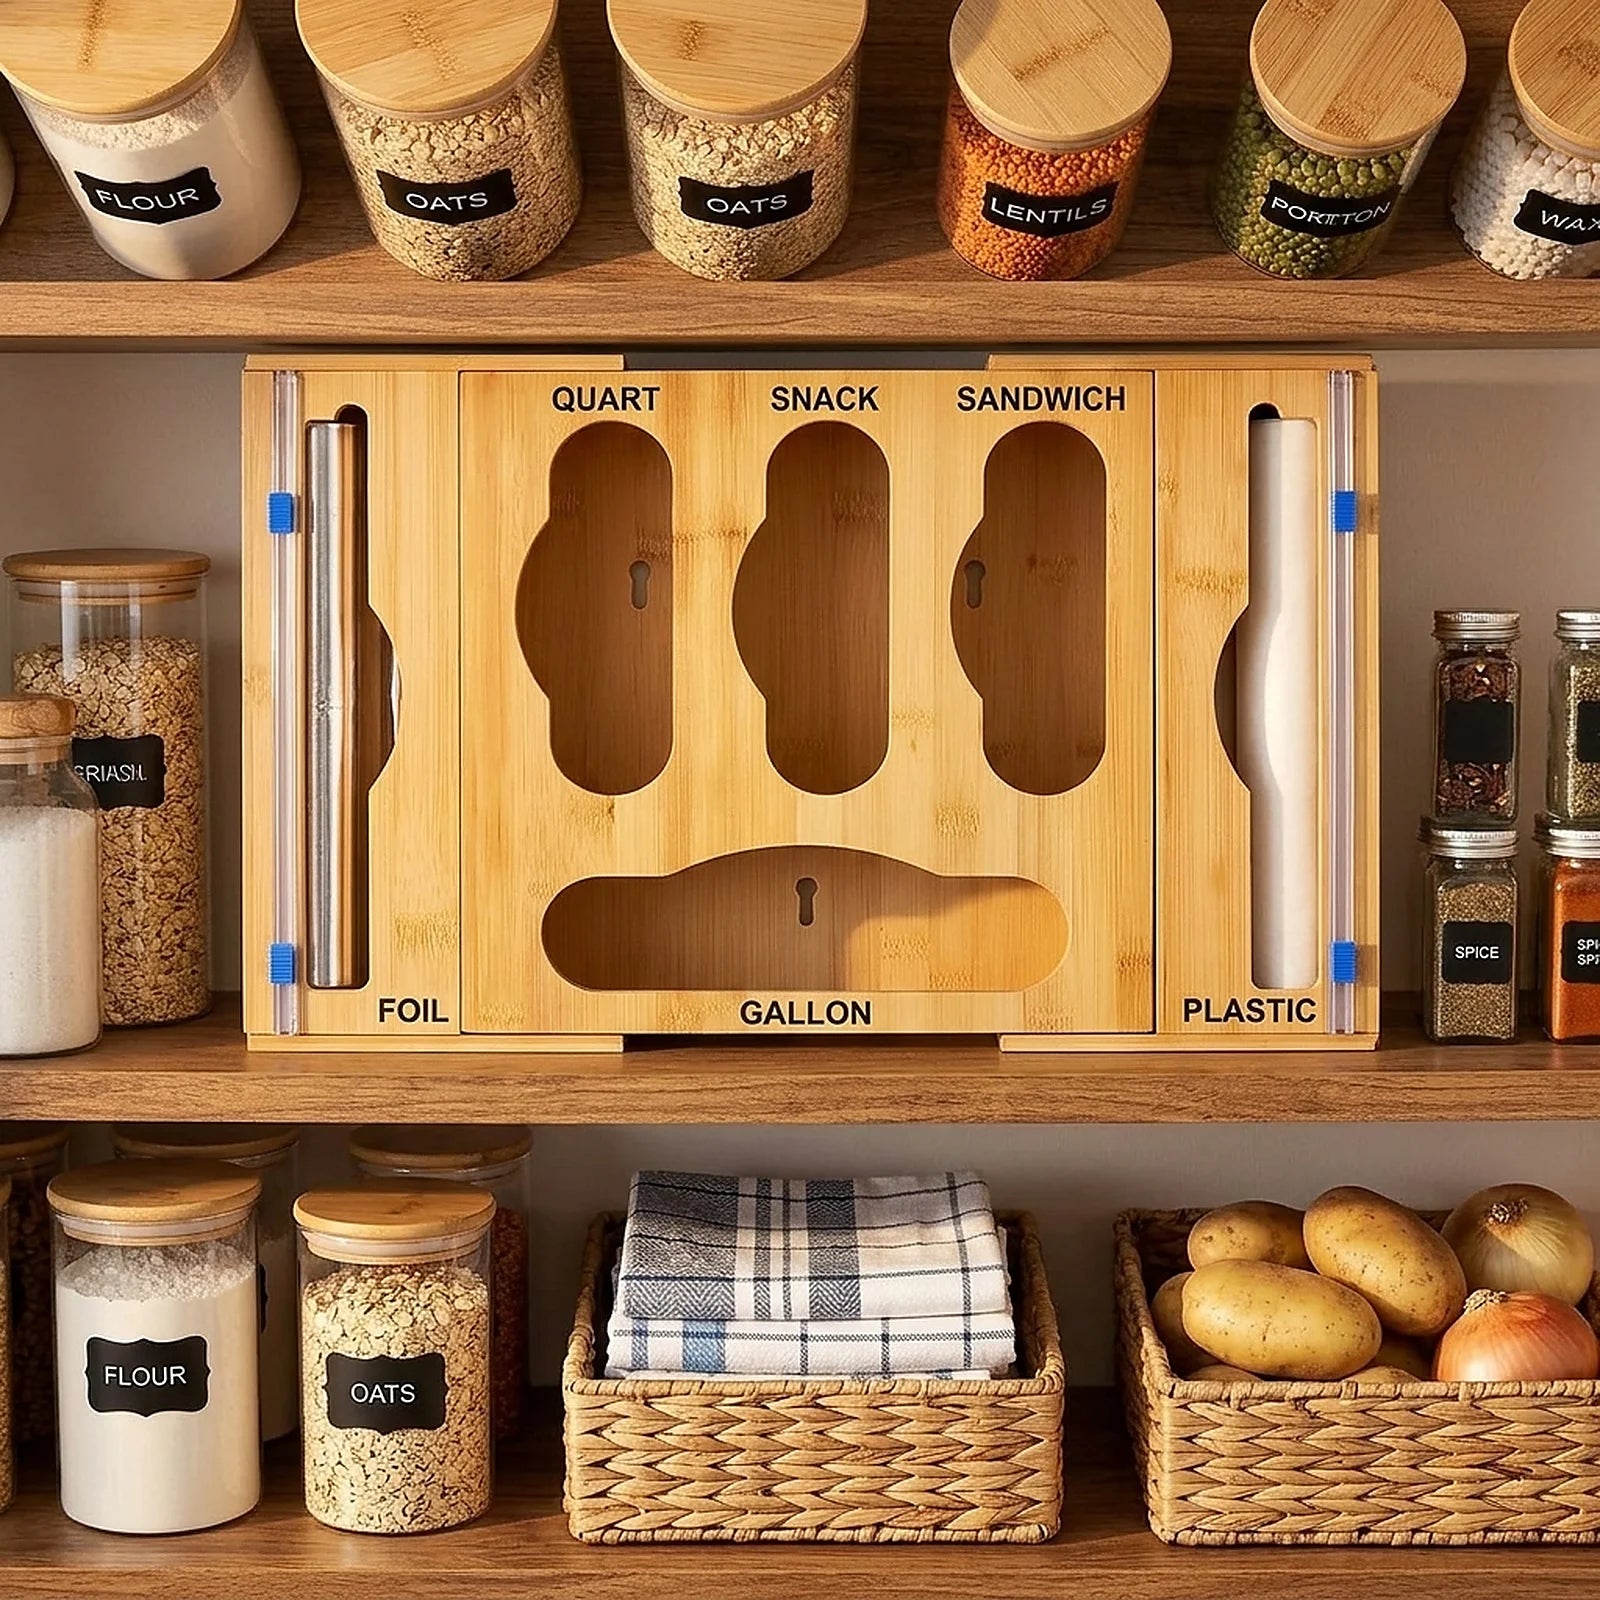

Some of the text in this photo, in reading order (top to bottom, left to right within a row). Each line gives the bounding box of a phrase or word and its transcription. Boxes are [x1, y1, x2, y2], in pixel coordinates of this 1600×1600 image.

[95, 186, 200, 210] FLOUR
[404, 192, 489, 212] OATS
[706, 194, 788, 214] OATS
[989, 199, 1107, 225] LENTILS
[552, 386, 661, 412] QUART
[771, 385, 879, 412] SNACK
[957, 385, 1126, 412] SANDWICH
[1455, 945, 1500, 959] SPICE
[379, 998, 449, 1023] FOIL
[740, 1000, 873, 1025] GALLON
[1183, 998, 1318, 1023] PLASTIC
[104, 1365, 187, 1388] FLOUR
[350, 1382, 416, 1404] OATS
